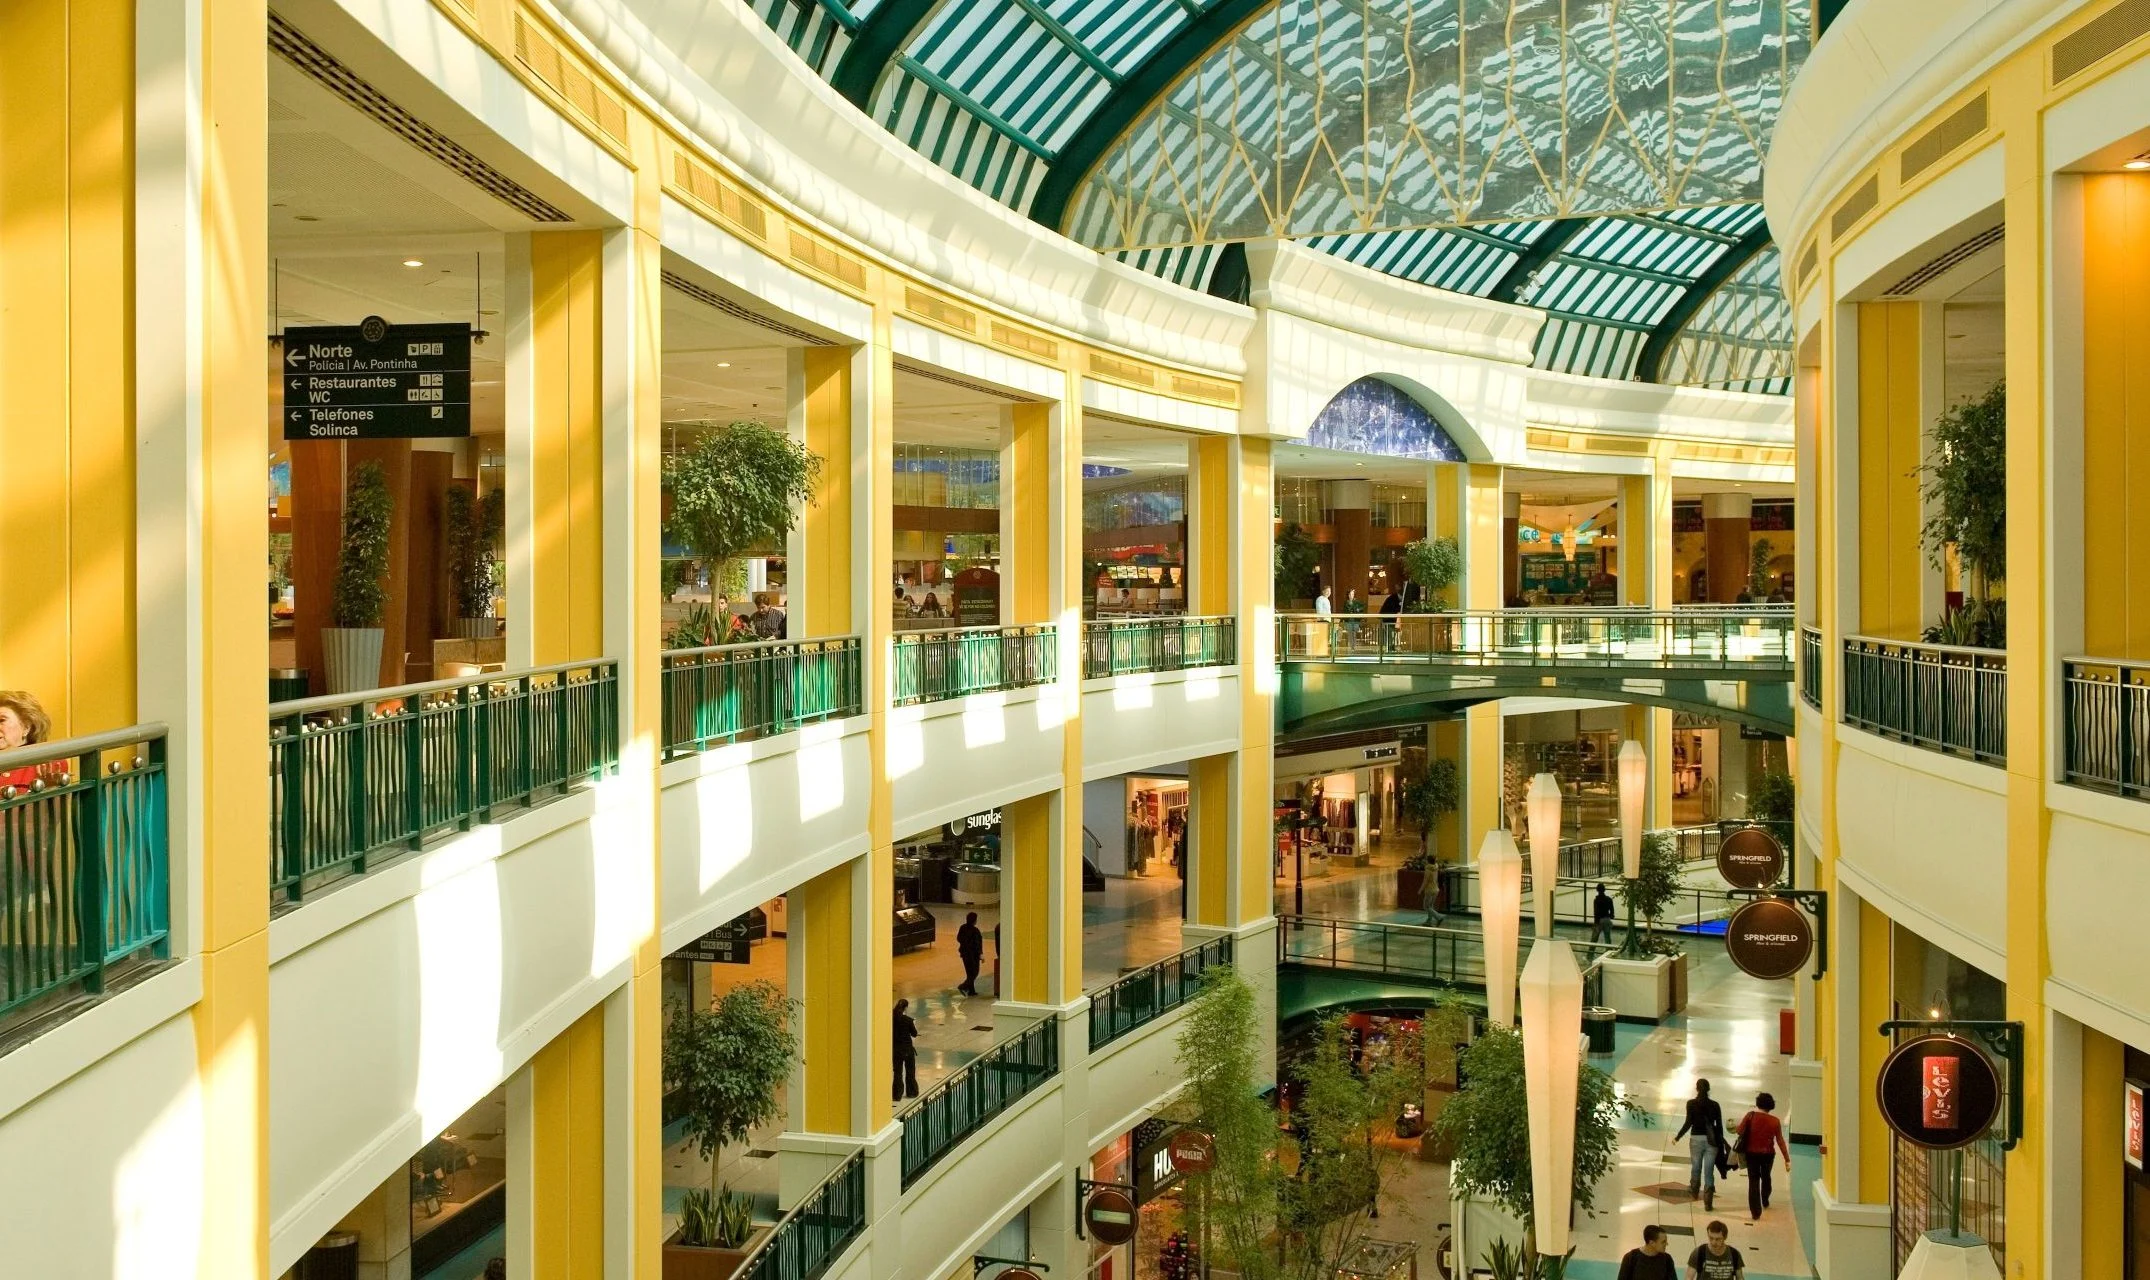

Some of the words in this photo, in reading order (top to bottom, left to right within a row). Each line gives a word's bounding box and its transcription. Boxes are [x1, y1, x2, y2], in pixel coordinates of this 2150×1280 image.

[309, 344, 353, 358] Norte
[309, 360, 345, 371] Polícia
[353, 360, 368, 370] Av.
[370, 358, 418, 370] Pontinha
[309, 377, 397, 389] Restaurantes
[309, 391, 331, 403] WC
[309, 409, 374, 421] Telefones
[309, 424, 358, 436] Solinca
[1729, 854, 1772, 862] SPRINGFIELD
[715, 929, 733, 939] Bus
[1743, 933, 1799, 942] SPRINGFIELD
[1176, 1149, 1203, 1161] PUMA
